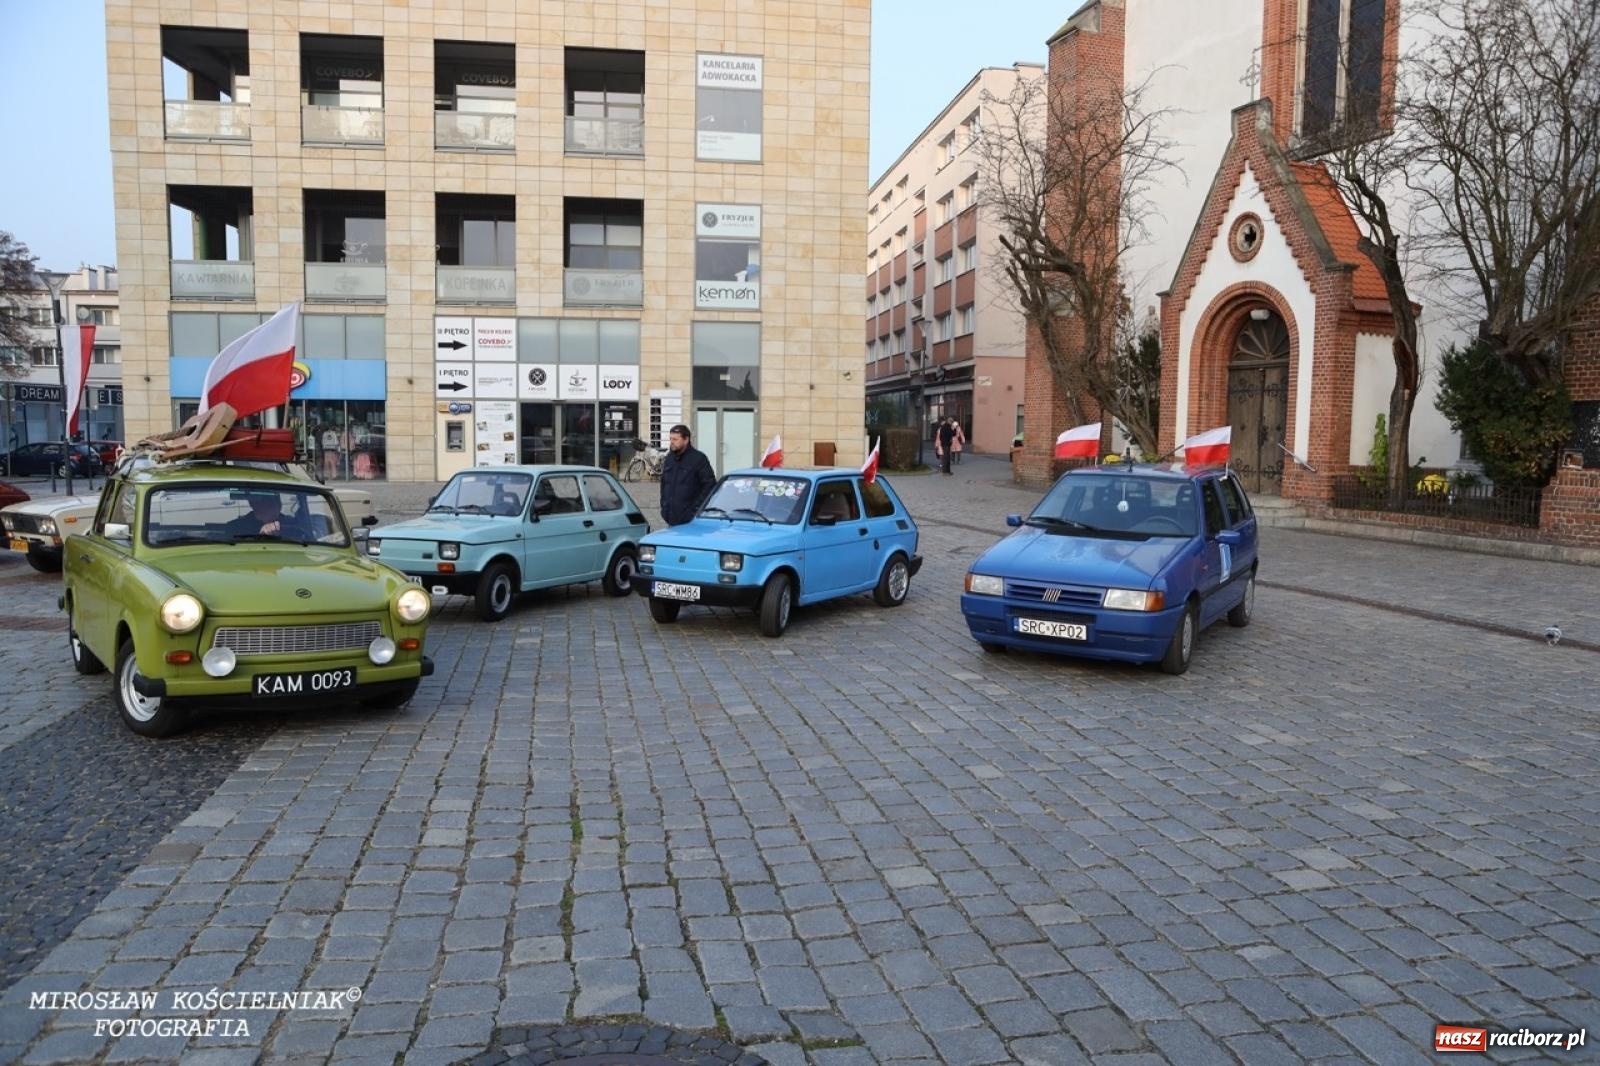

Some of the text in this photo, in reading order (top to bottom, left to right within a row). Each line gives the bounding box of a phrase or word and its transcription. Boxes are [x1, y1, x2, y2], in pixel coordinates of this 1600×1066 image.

[703, 60, 756, 71] KANCELARIA
[702, 71, 757, 82] ADWOKACKA
[177, 271, 249, 285] KAWIARNIA
[444, 328, 470, 336] PIĘTRO
[443, 369, 469, 377] PIĘTRO
[603, 379, 633, 389] LODY
[20, 387, 60, 400] DREAM
[256, 670, 352, 695] KAM 0093
